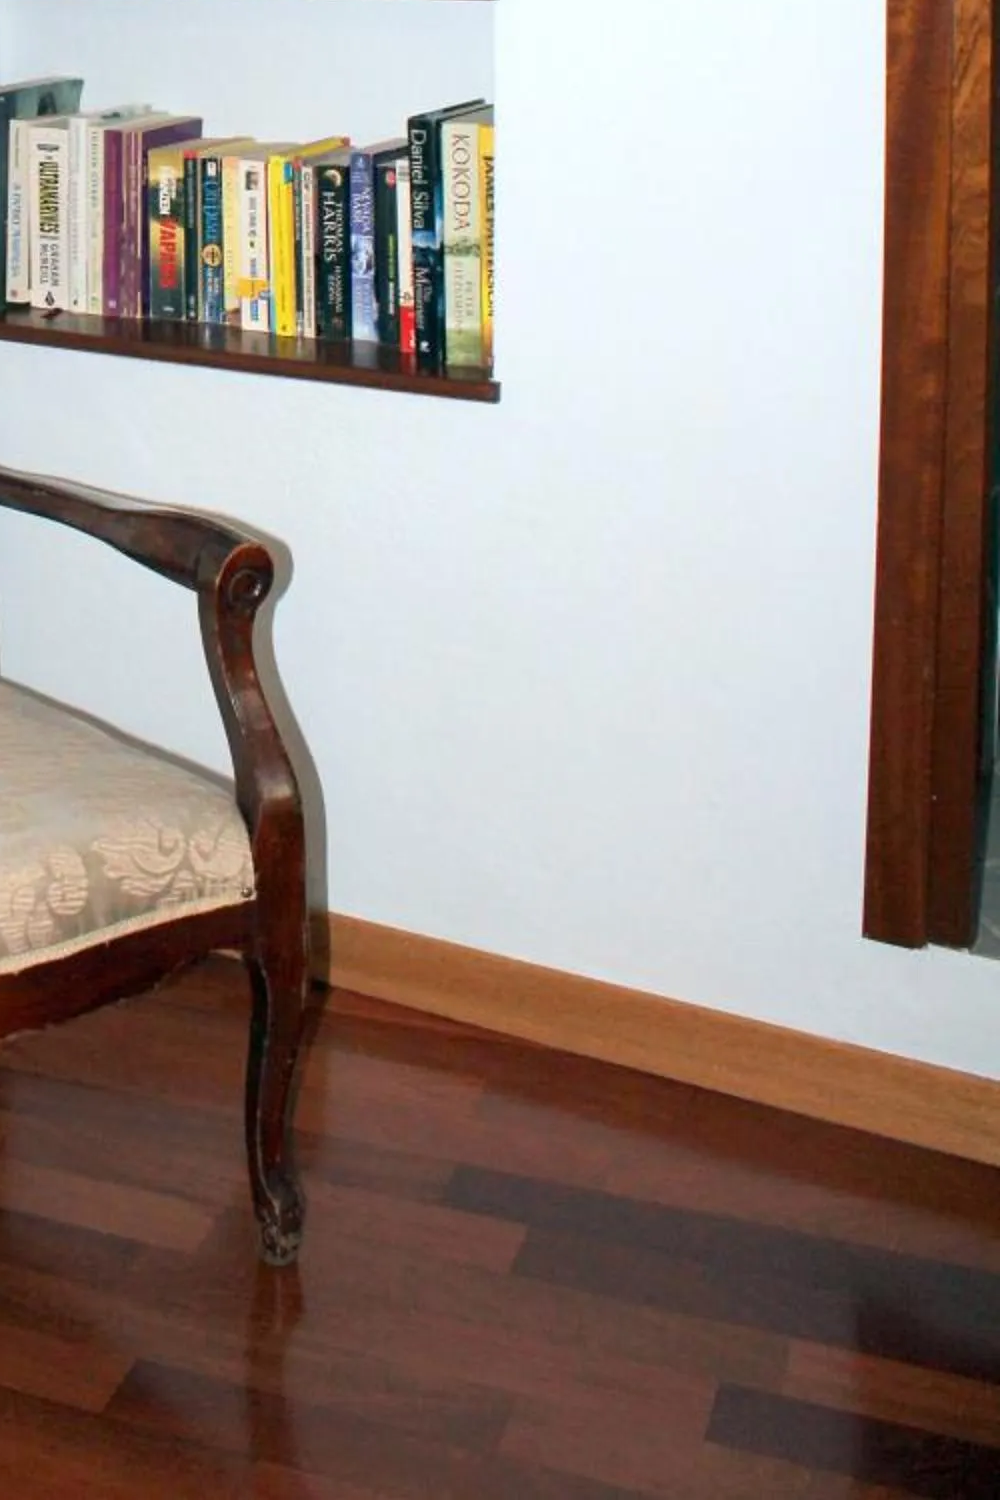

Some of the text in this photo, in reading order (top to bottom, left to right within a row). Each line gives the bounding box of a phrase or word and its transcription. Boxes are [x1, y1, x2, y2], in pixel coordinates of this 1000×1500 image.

[39, 161, 60, 234] ULTRAMARINES
[411, 129, 428, 229] Daniel Silva
[451, 133, 471, 232] KOKODA
[483, 156, 494, 212] JAMES
[323, 191, 336, 262] HARRIS
